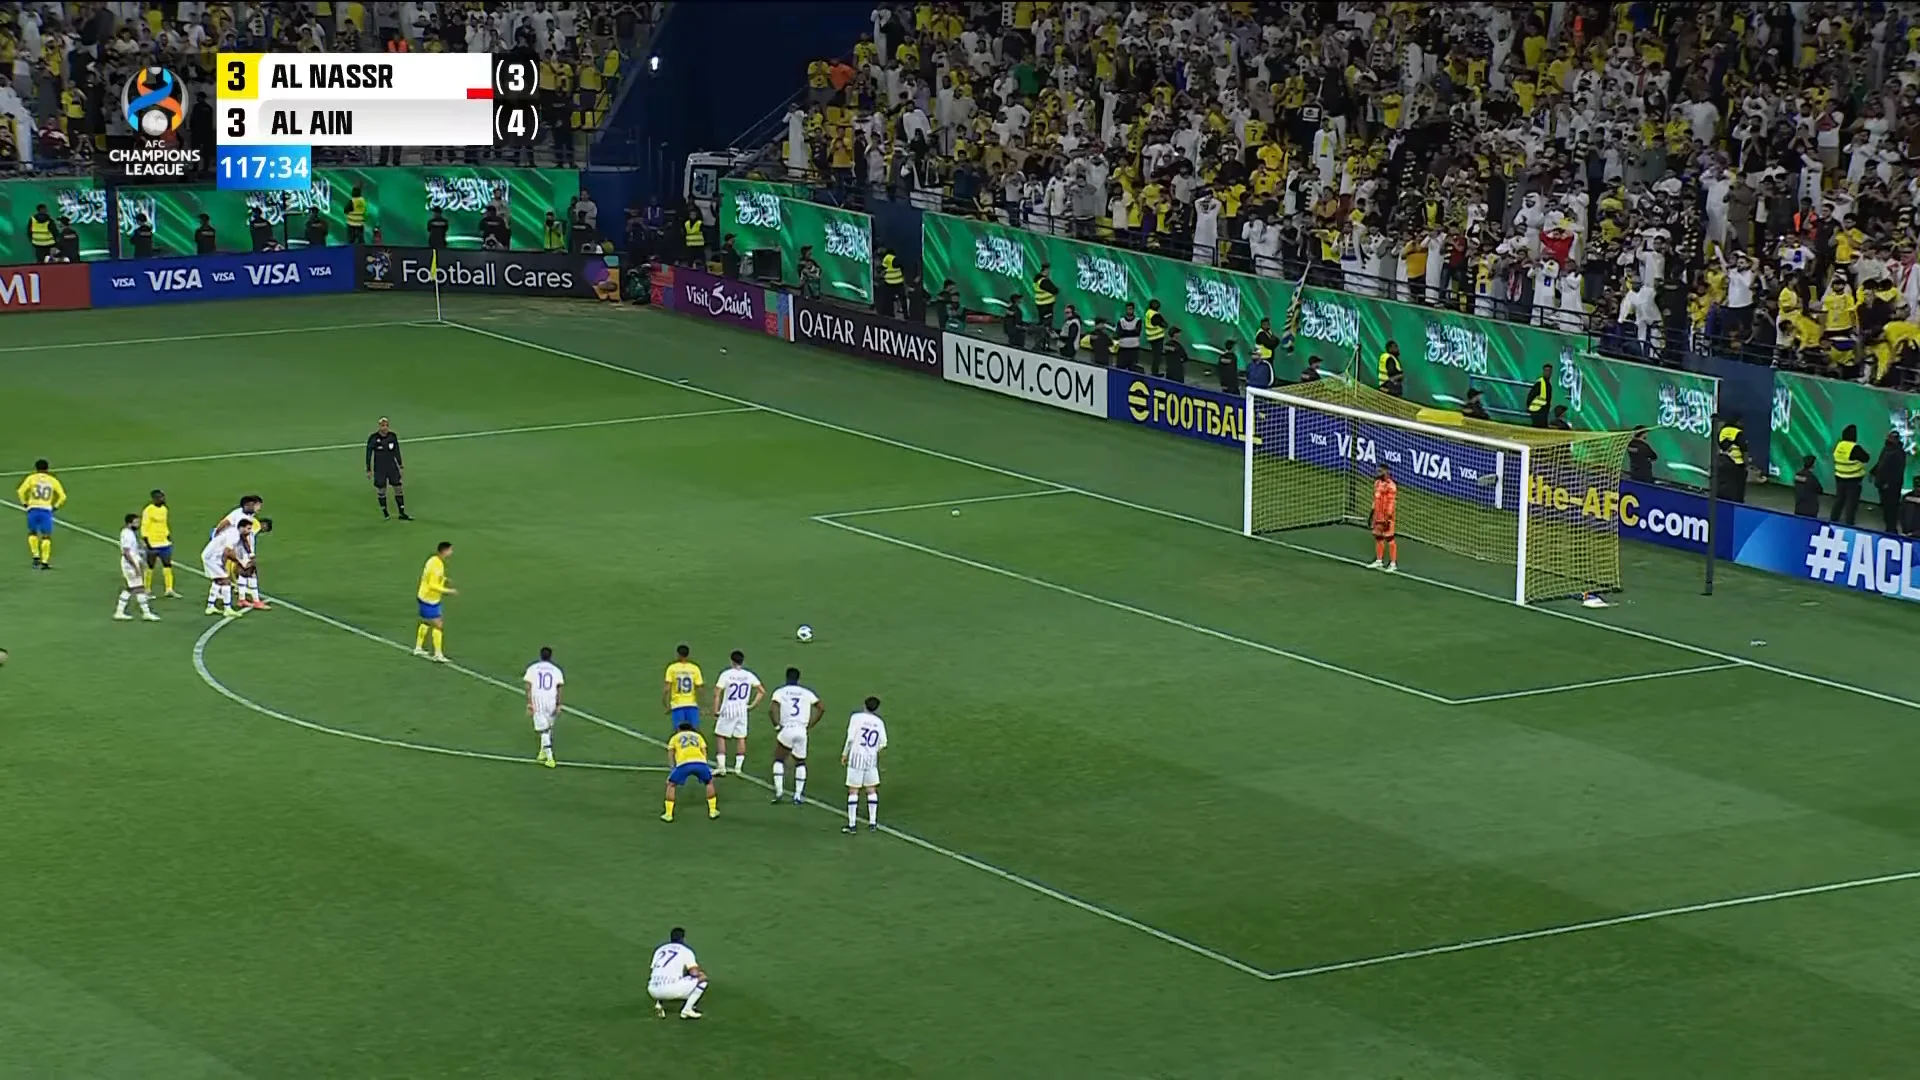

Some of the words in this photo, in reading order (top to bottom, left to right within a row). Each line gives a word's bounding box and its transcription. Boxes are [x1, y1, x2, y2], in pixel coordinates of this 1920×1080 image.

[112, 277, 136, 288] VISA
[144, 268, 203, 291] VISA
[211, 271, 235, 283] VISA
[243, 263, 300, 286] VISA
[308, 266, 332, 276] VISA
[402, 260, 496, 286] Football
[504, 264, 573, 288] Cares
[686, 284, 709, 308] Visit
[709, 282, 753, 319] Saudi
[799, 309, 856, 346] QATAR
[862, 325, 937, 366] AIRWAYS
[955, 342, 1094, 406] NEOM.COM
[1310, 432, 1327, 446] VISA
[1334, 431, 1377, 464] VISA
[1384, 449, 1401, 463] VISA
[1409, 448, 1452, 481] VISA
[1459, 467, 1478, 480] VISA
[32, 484, 52, 501] 30
[1528, 474, 1709, 543] the-AFC.com
[538, 671, 553, 691] 10
[677, 676, 692, 694] 19
[728, 683, 749, 700] 20
[790, 697, 800, 717] 3
[860, 727, 879, 747] 30
[654, 949, 678, 968] 27
